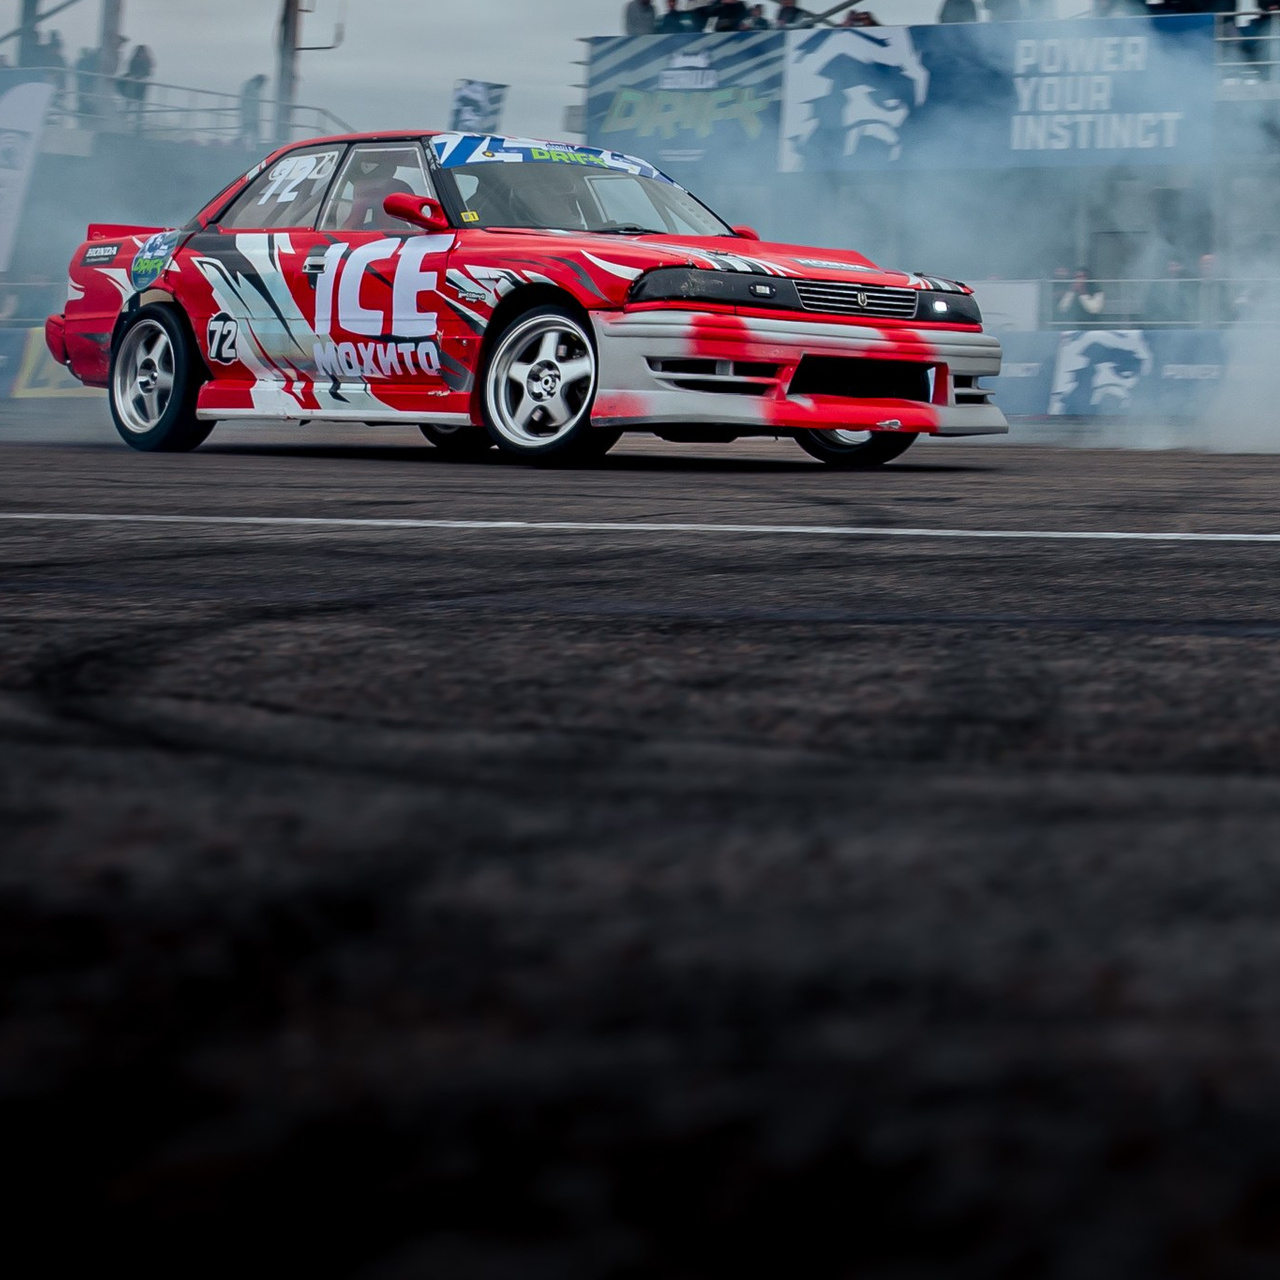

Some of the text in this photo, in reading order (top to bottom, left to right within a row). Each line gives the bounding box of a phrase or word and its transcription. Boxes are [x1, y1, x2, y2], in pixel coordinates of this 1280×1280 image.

[1013, 36, 1148, 74] POWER
[1013, 75, 1113, 112] YOUR
[1010, 111, 1184, 150] INSTINCT
[531, 148, 609, 168] DRIFT
[86, 246, 118, 257] HONDA
[315, 234, 455, 336] ICE
[208, 320, 238, 359] 72
